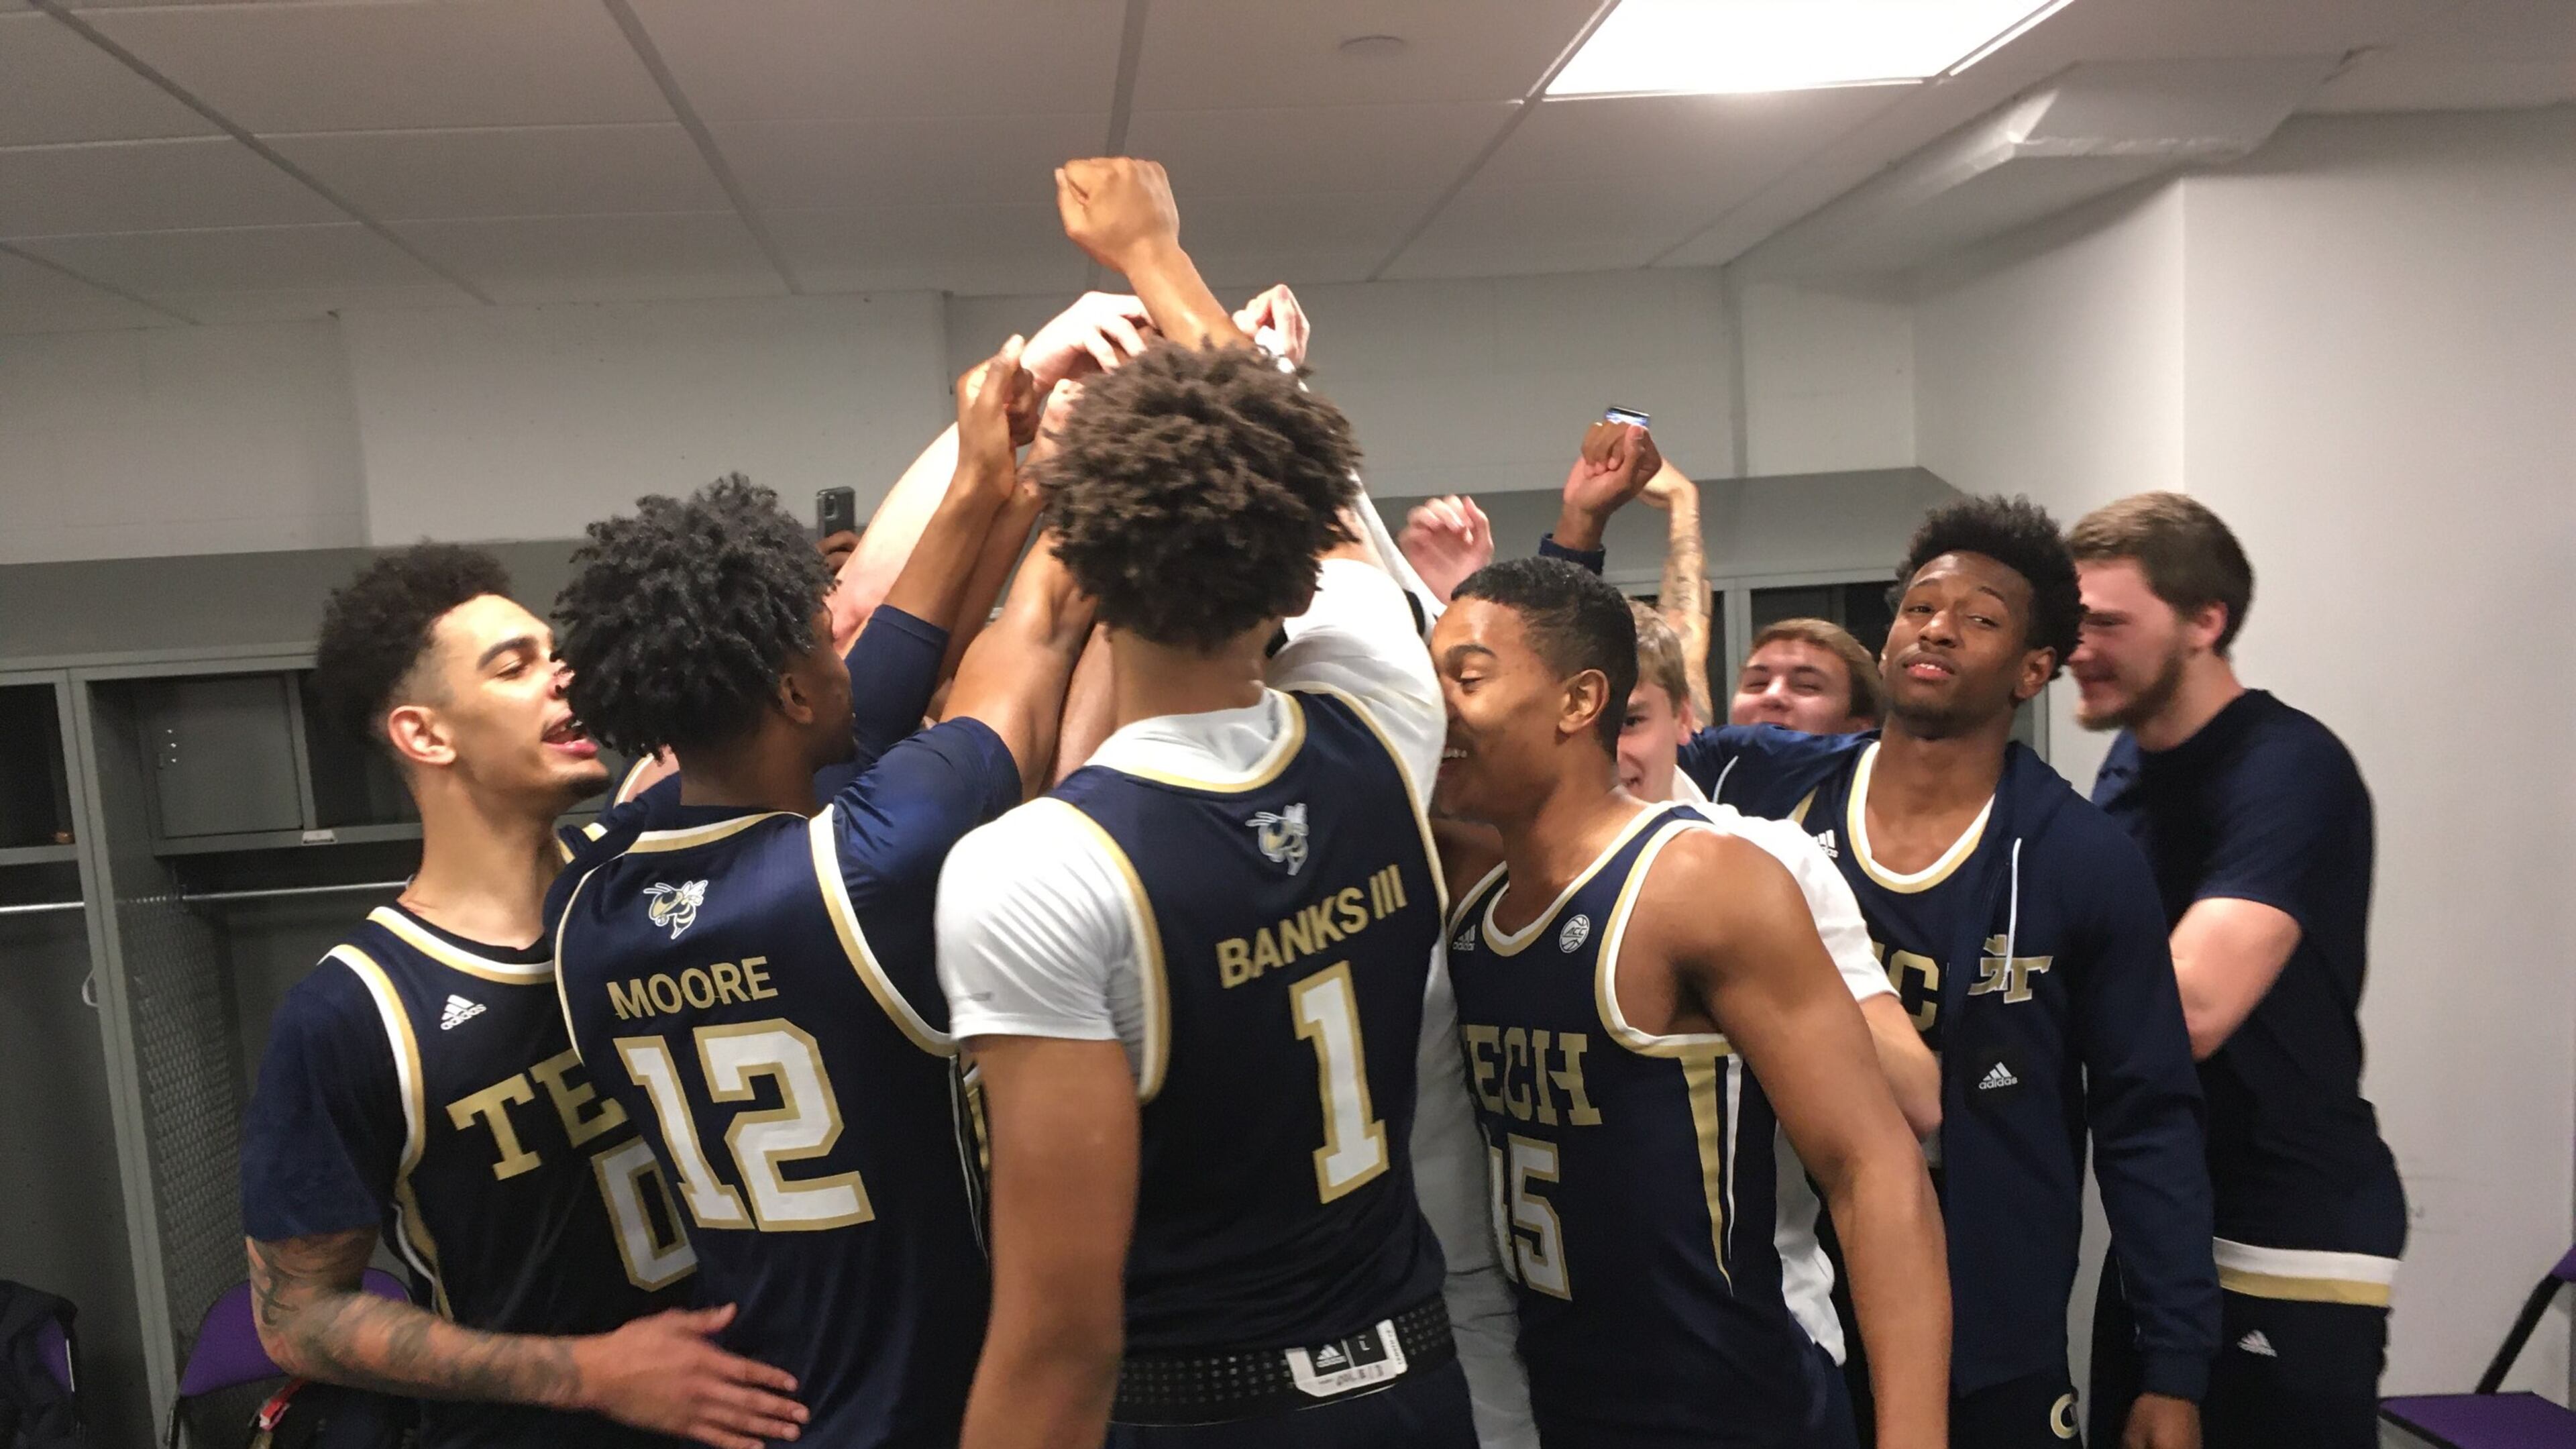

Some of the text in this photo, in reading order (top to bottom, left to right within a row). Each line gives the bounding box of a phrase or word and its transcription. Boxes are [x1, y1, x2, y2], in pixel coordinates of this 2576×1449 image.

[1215, 863, 1408, 989] BANKS III
[1564, 927, 1587, 936] ACC
[440, 1004, 487, 1030] adidas
[606, 956, 778, 1020] MOORE
[1289, 960, 1389, 1204] 1
[1978, 1076, 2019, 1090] adidas
[612, 1018, 875, 1232] 12
